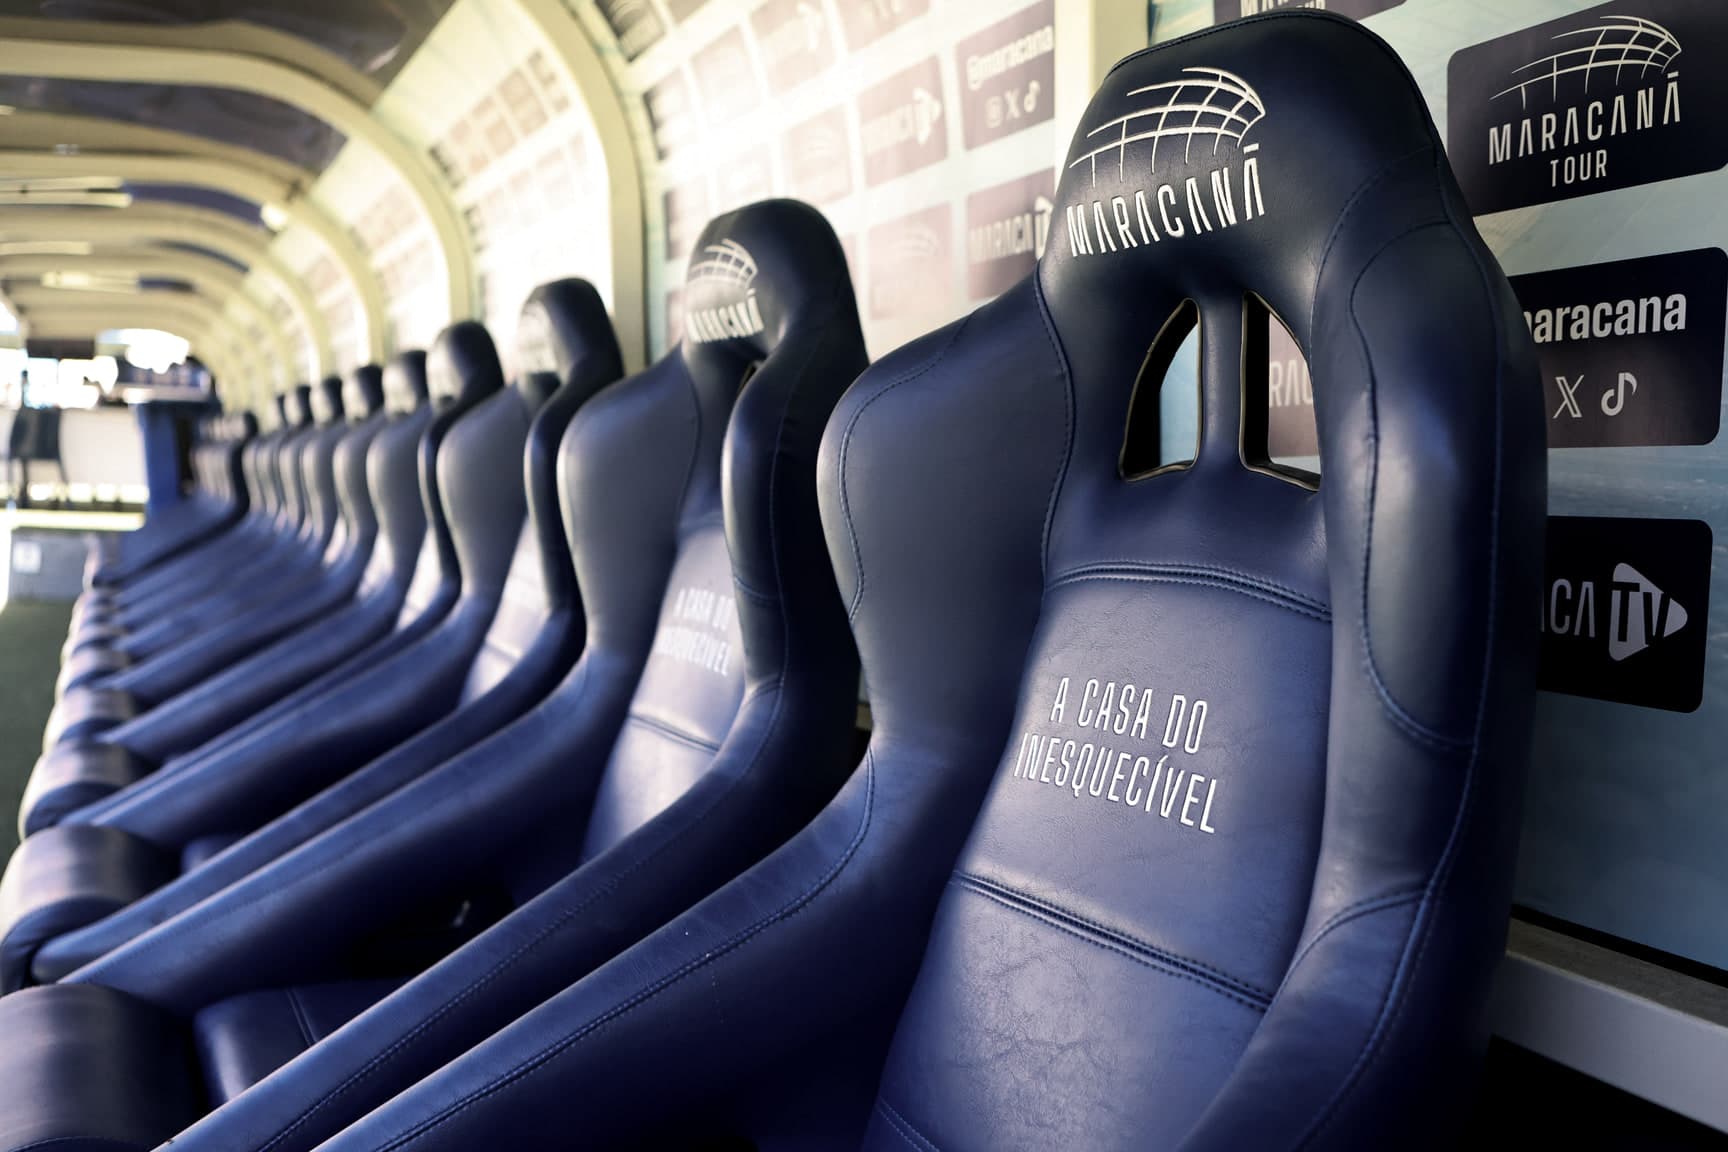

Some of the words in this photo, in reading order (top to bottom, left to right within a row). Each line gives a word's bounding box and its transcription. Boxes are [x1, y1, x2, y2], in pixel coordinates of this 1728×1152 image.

[1550, 149, 1608, 188] TOUR
[1050, 677, 1070, 723] A
[1077, 678, 1153, 740] CASA
[1161, 694, 1208, 754] DO
[1013, 732, 1217, 834] INESQUECÍVEL
